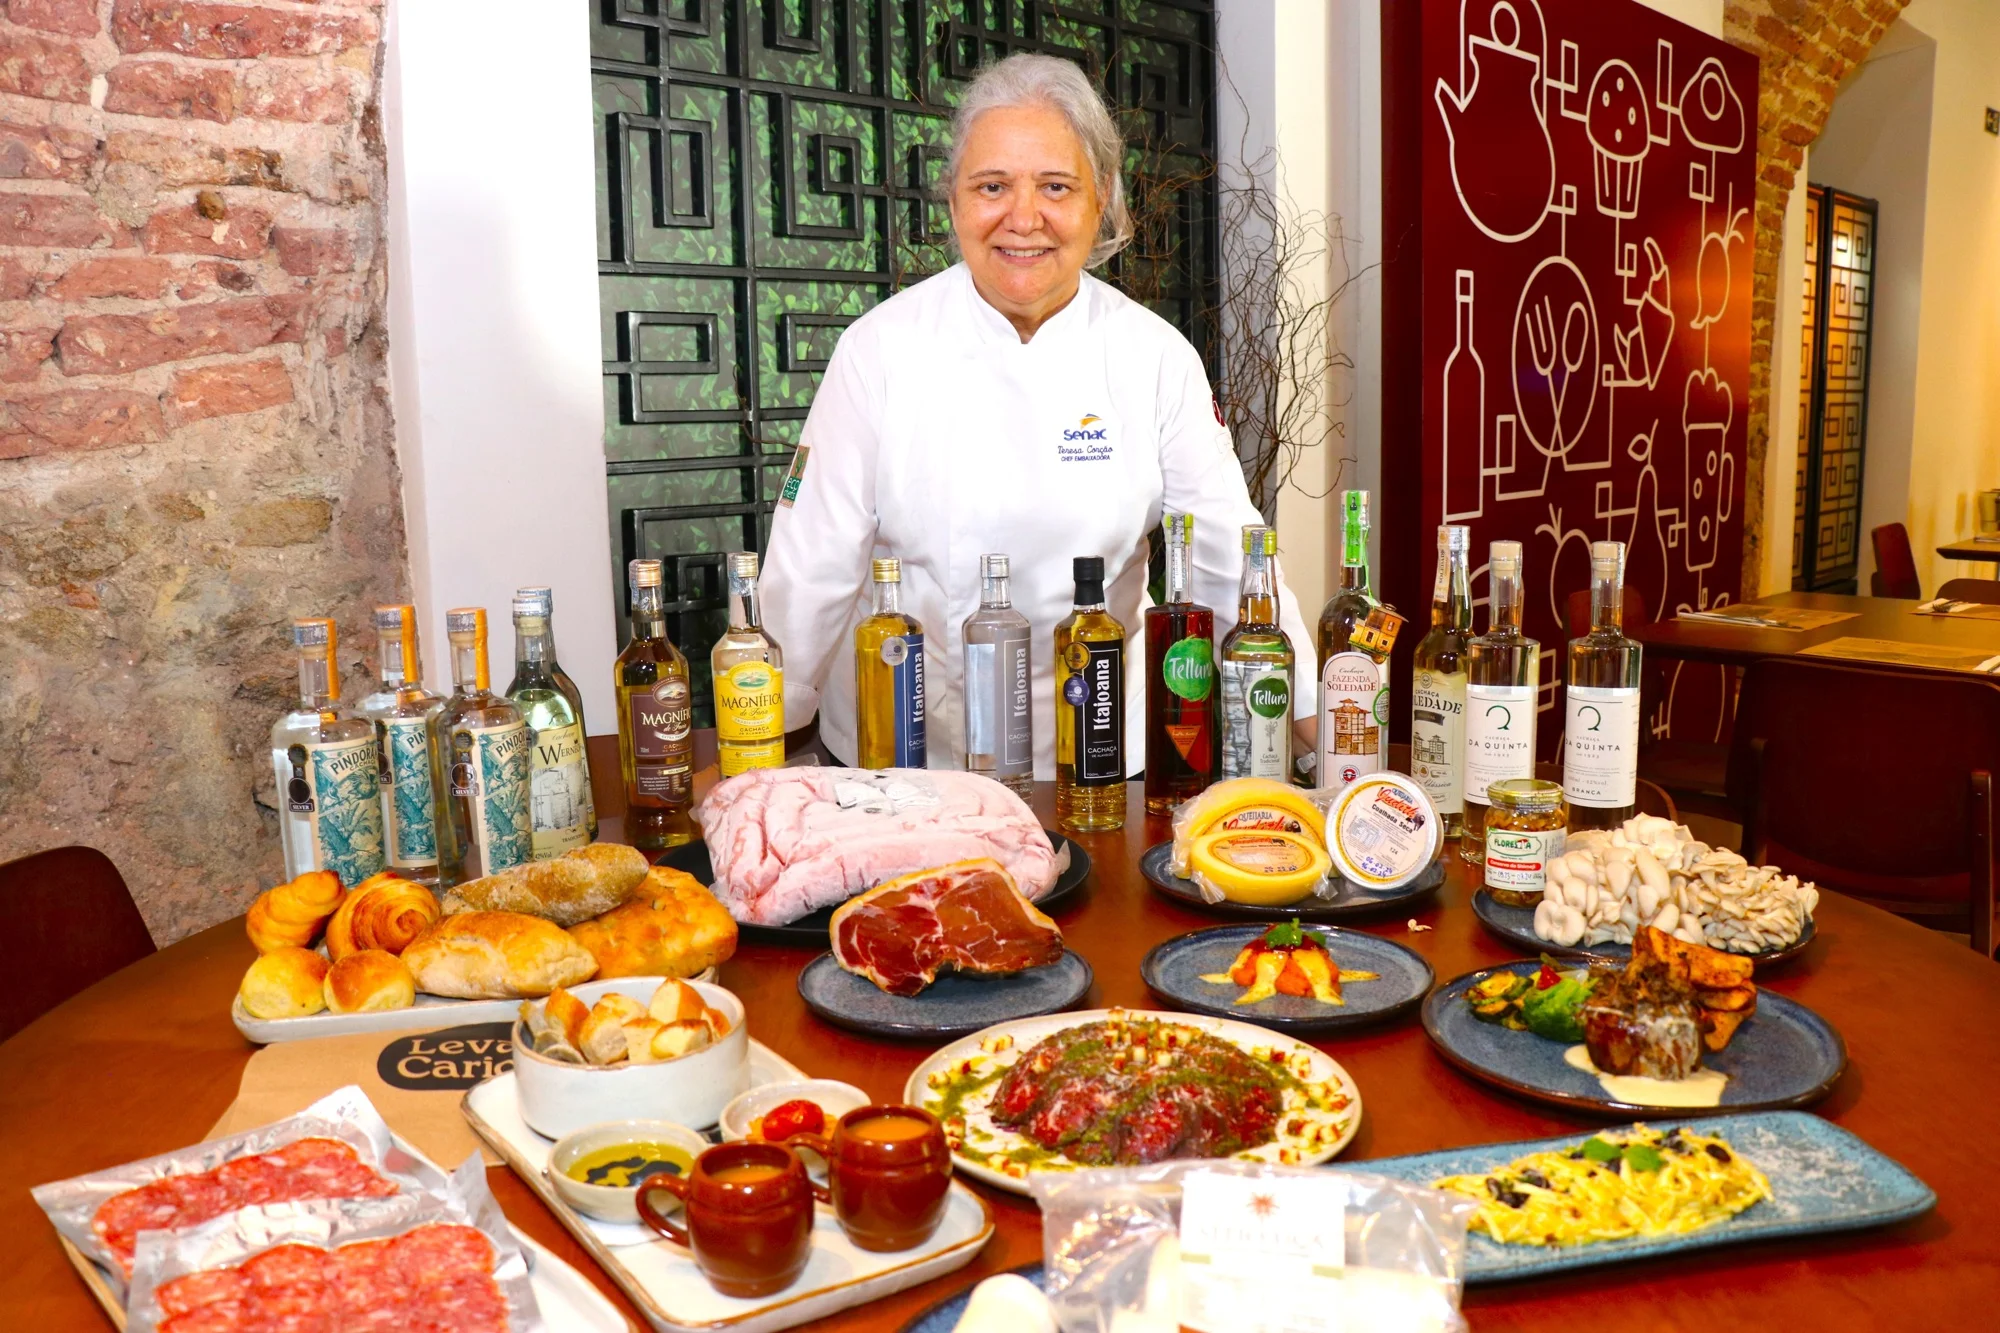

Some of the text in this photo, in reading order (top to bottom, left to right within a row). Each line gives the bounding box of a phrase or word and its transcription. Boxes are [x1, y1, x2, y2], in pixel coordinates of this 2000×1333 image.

[1063, 428, 1107, 441] Senac
[1057, 445, 1084, 454] Teresa
[1168, 657, 1213, 680] Tellura
[1013, 647, 1029, 718] Itajoana
[1331, 674, 1371, 683] FAZENDA
[913, 652, 925, 723] Itajoana
[1326, 680, 1376, 692] SOLEDADE
[720, 692, 782, 710] MAGNÍFICA
[1092, 658, 1113, 731] Itajoana
[1253, 690, 1287, 706] Tellura
[1087, 745, 1118, 754] CACHAÇA
[1484, 742, 1529, 750] QUINTA
[1576, 742, 1621, 752] QUINTA
[1571, 786, 1602, 796] BRANCA
[1238, 810, 1273, 823] QUEIJARIA
[1371, 803, 1398, 824] Coalhada
[1398, 820, 1413, 834] Seca
